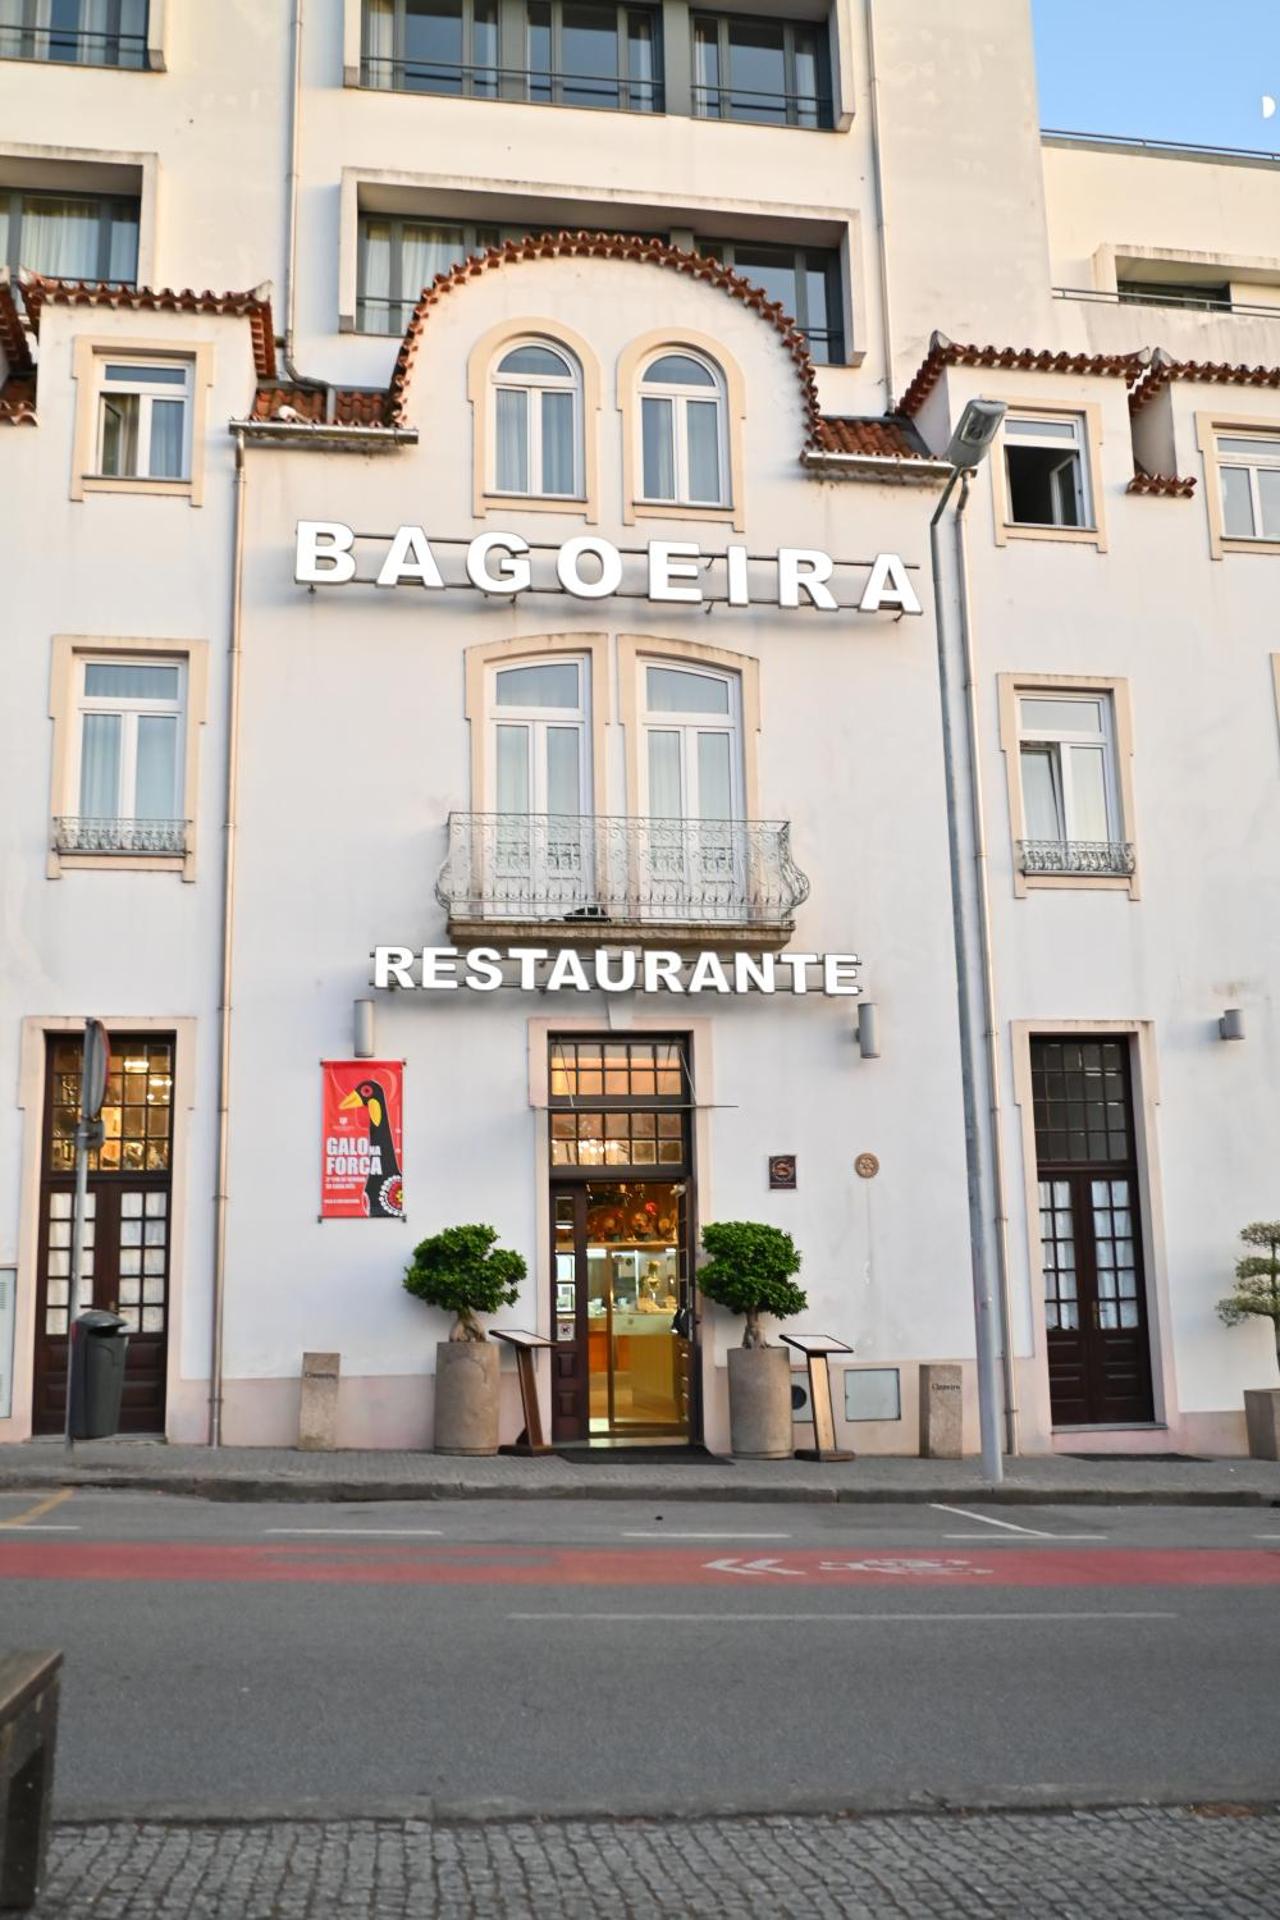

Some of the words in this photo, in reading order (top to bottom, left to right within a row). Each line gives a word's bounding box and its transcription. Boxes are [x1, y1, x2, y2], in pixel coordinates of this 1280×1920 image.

[295, 521, 922, 615] BAGOEIRA
[374, 946, 860, 995] RESTAURANTE
[327, 1137, 369, 1156] GALO
[326, 1156, 383, 1175] FORCA
